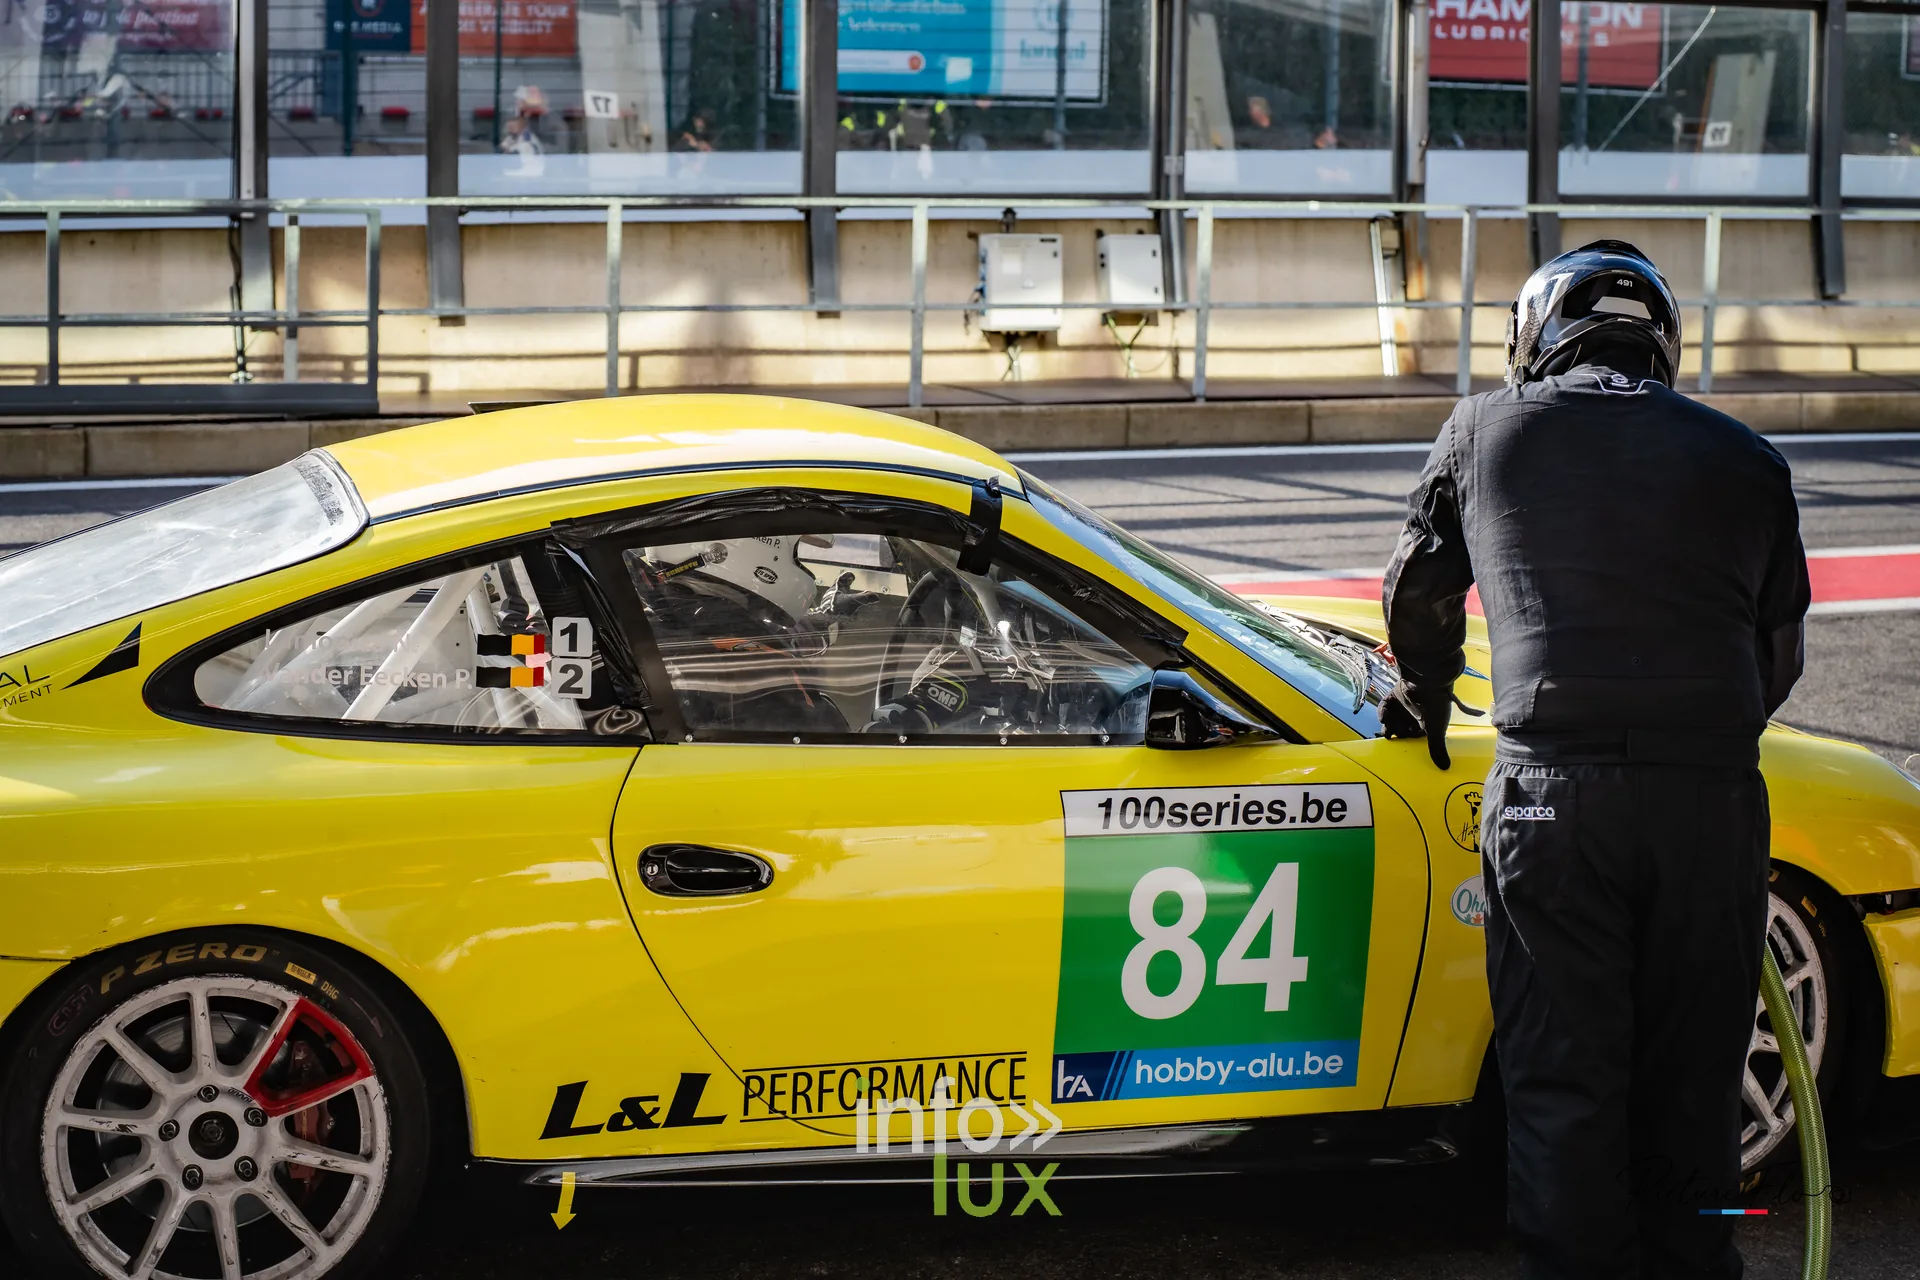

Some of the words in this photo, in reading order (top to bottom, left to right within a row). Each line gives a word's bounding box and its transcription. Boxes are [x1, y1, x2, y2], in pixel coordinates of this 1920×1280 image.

[1428, 0, 1643, 28] HAMION
[1616, 278, 1633, 288] 491
[559, 622, 578, 653] 1
[360, 665, 447, 689] Eecken
[455, 668, 473, 690] P.
[557, 663, 584, 695] 2
[928, 686, 958, 706] OMP
[1097, 791, 1348, 830] 100series.be
[1504, 805, 1556, 821] sparco
[1120, 862, 1309, 1020] 84
[133, 942, 268, 977] ZERO
[320, 980, 340, 999] DHG
[1135, 1051, 1344, 1085] hobby-alu.be
[539, 1071, 728, 1141] L&L
[742, 1056, 1027, 1117] PERFORMANCE
